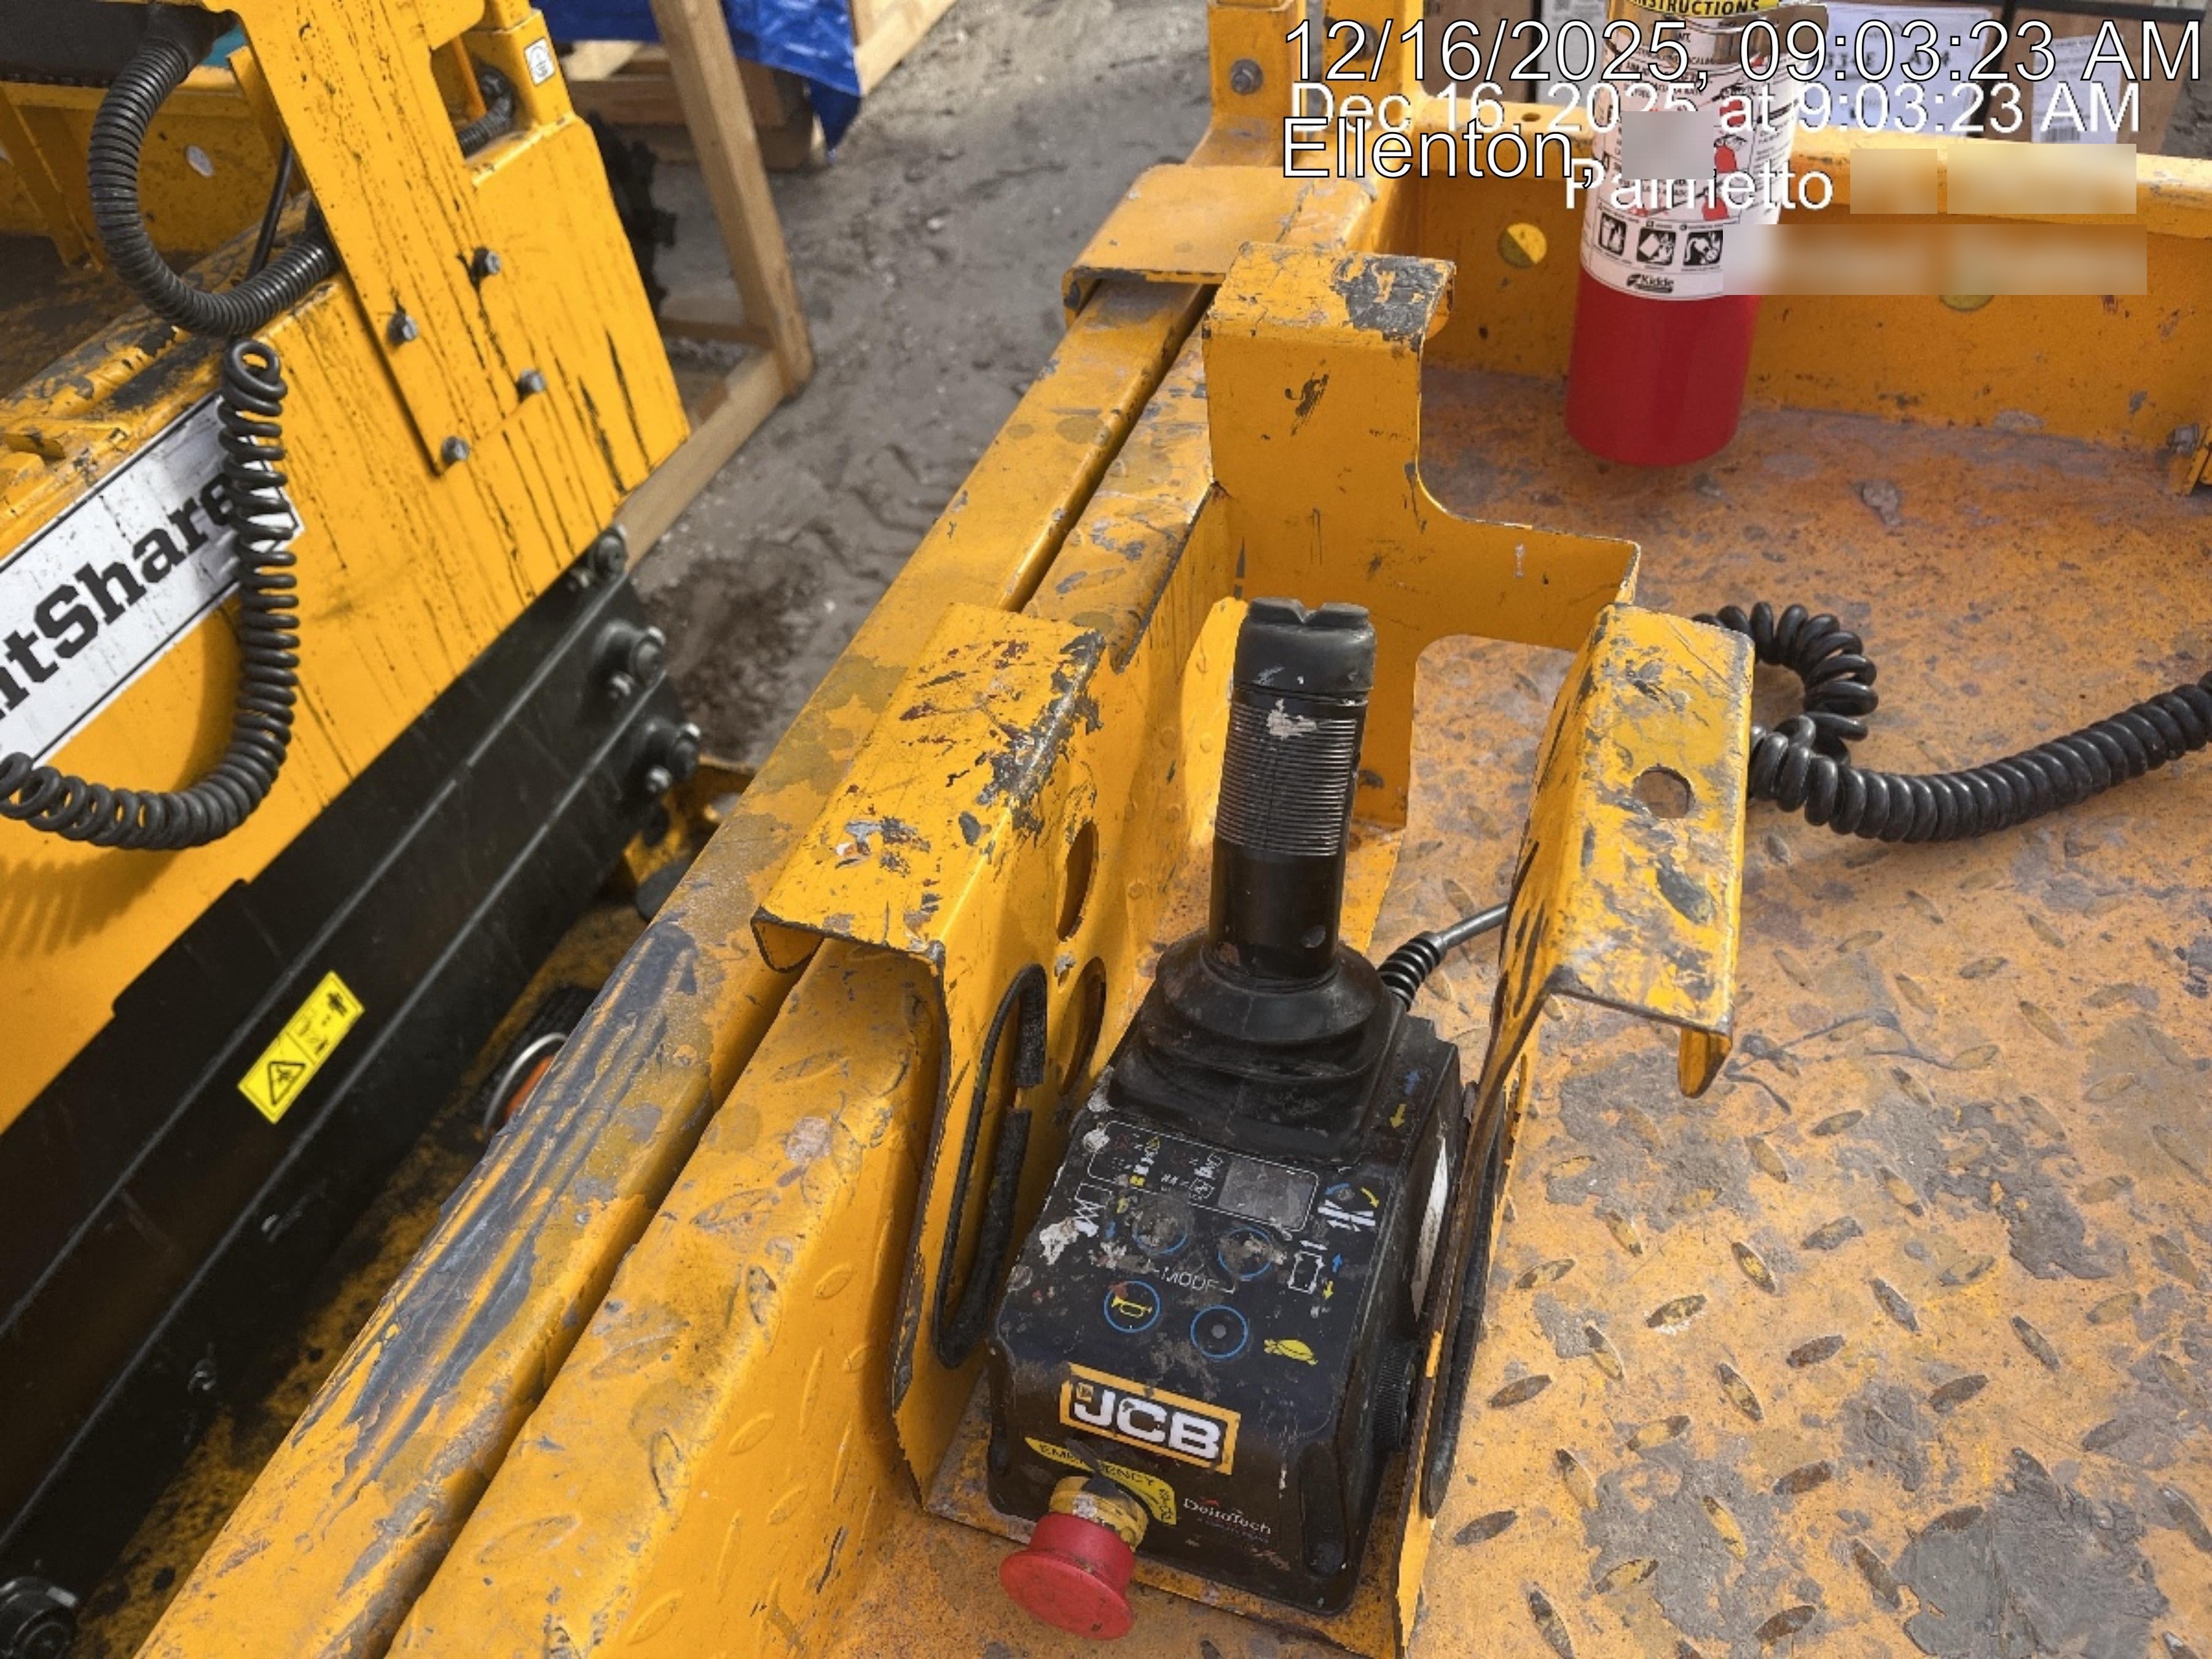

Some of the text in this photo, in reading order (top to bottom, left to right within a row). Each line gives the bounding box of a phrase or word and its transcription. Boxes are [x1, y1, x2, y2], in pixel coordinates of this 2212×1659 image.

[1634, 0, 1759, 15] STRUCTIONS
[1074, 1389, 1220, 1459] JCB
[1039, 1444, 1155, 1487] EMENCY
